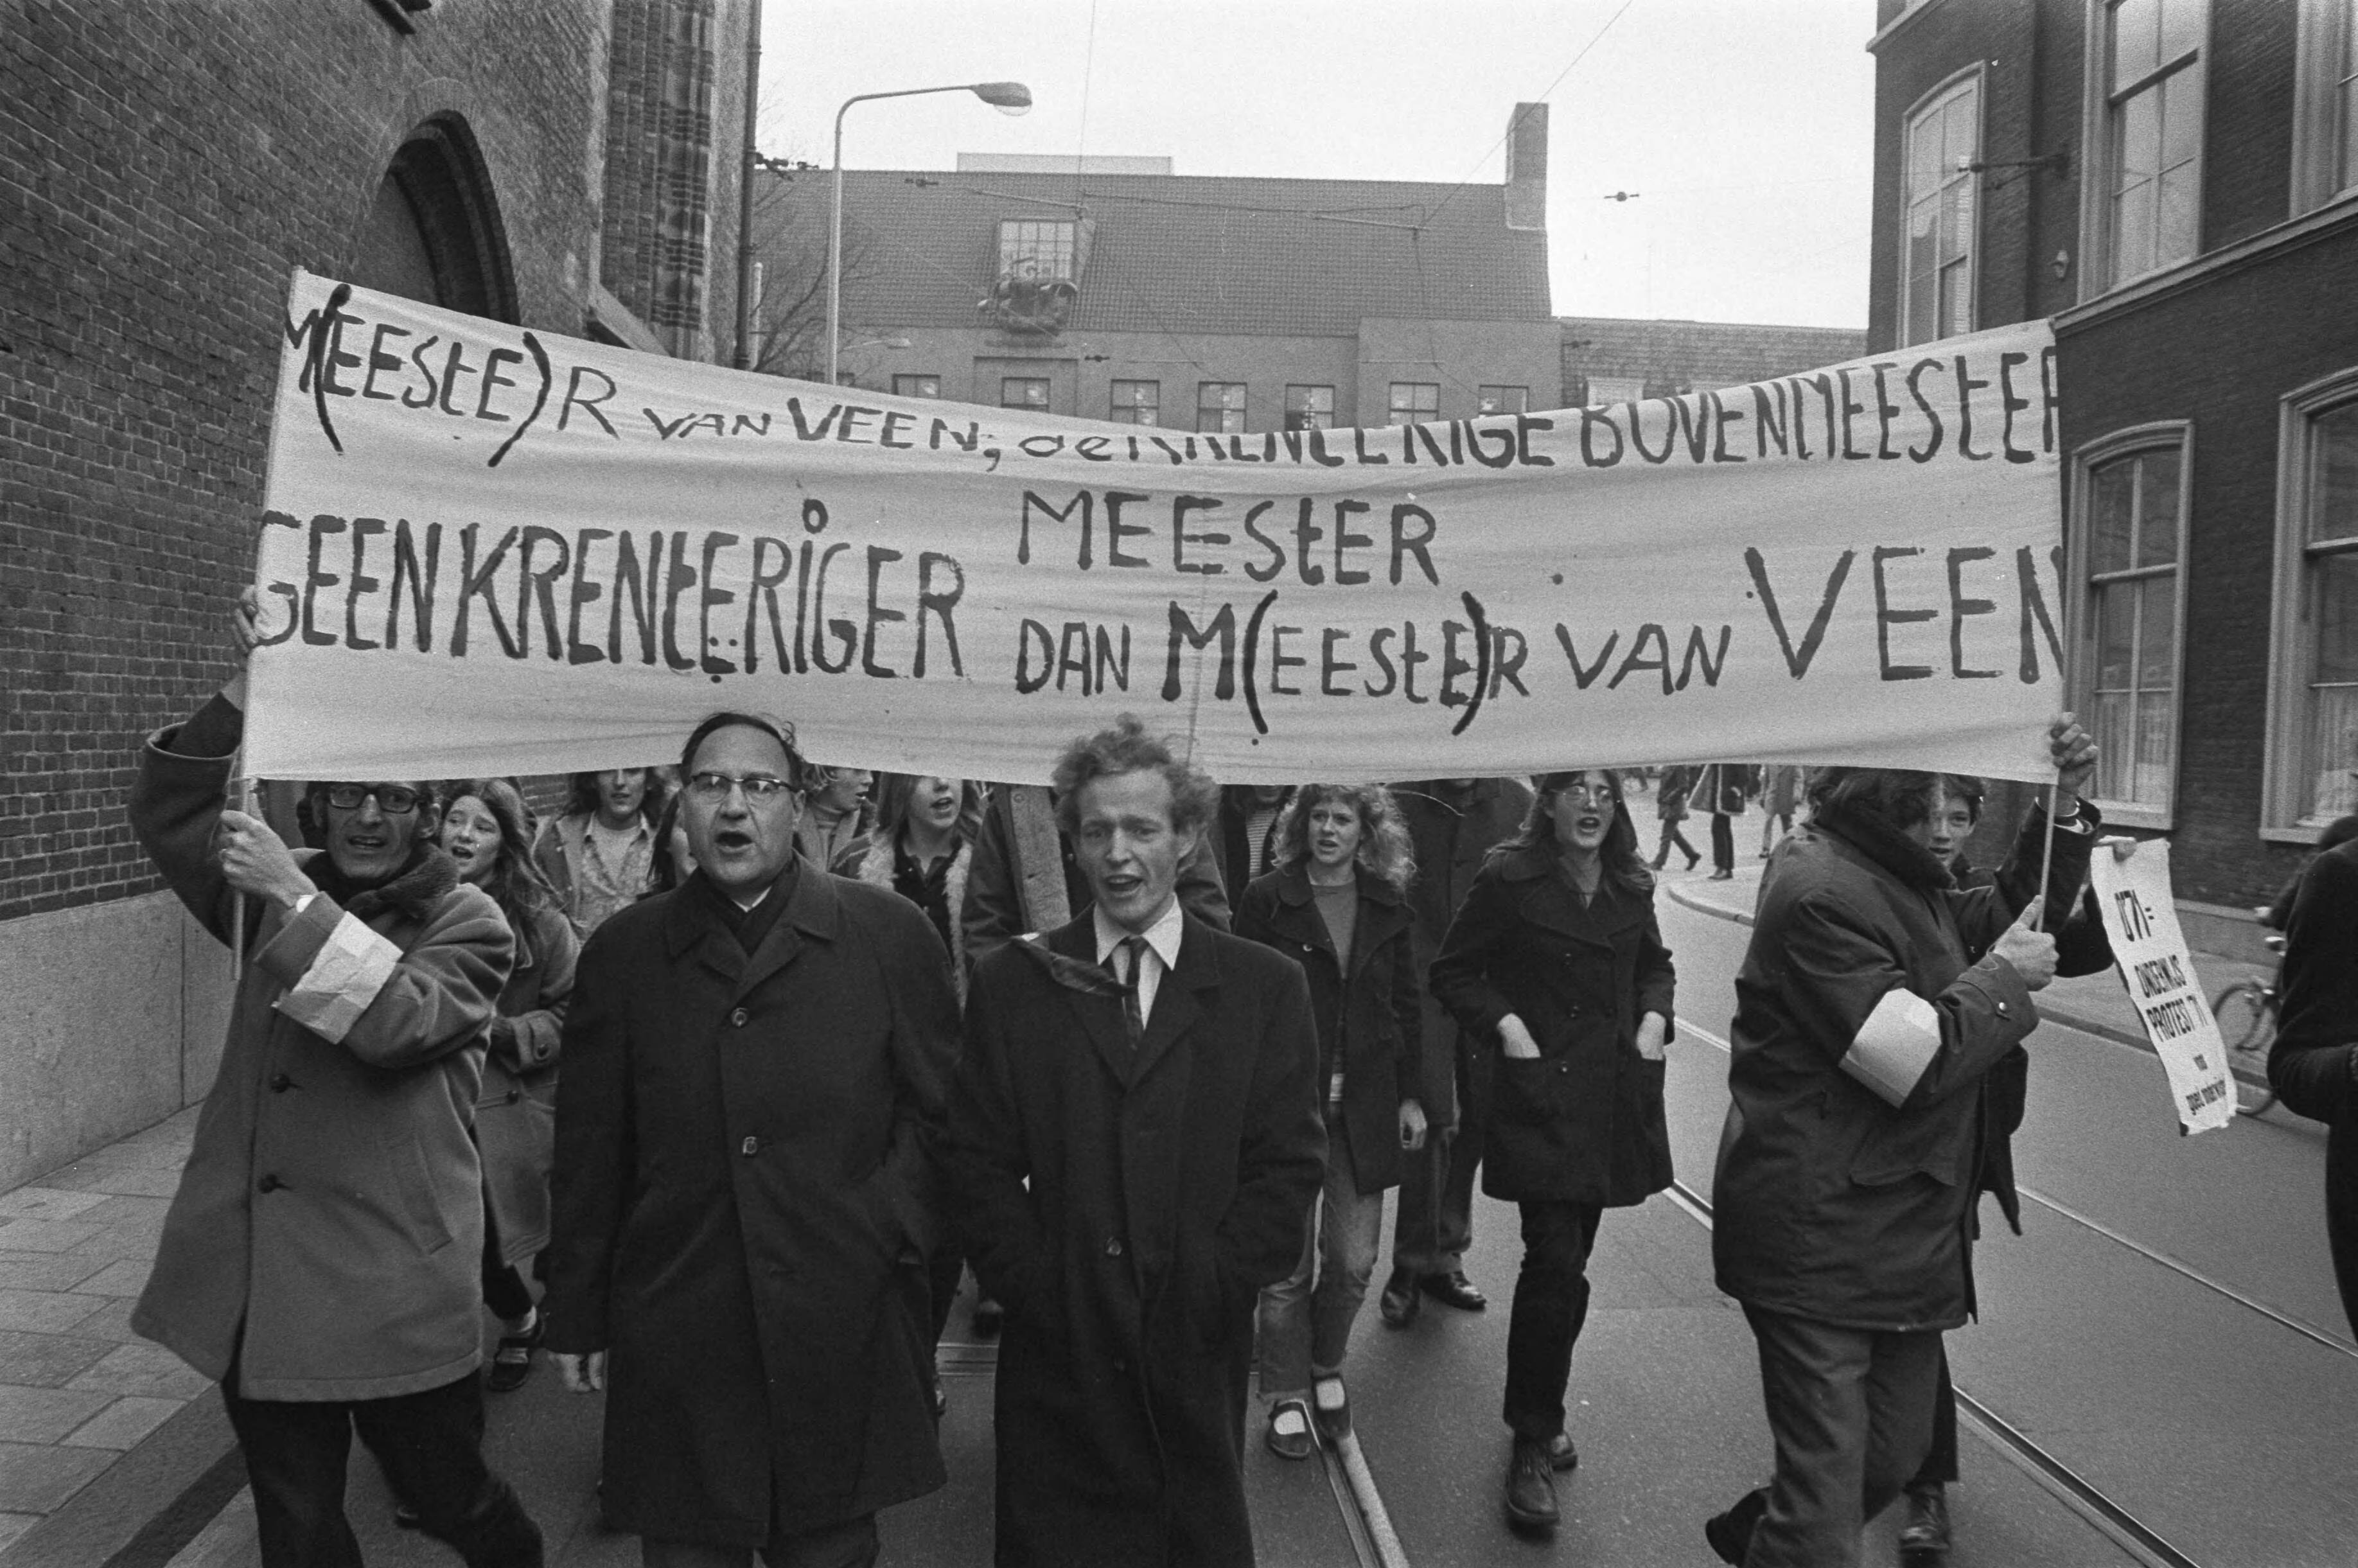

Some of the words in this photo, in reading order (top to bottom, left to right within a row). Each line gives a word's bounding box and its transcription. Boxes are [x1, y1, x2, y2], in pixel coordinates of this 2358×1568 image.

[643, 407, 771, 441] VAN
[1015, 618, 1131, 696] DAN
[1555, 623, 1732, 695] VAN
[1745, 545, 2064, 685] VEEN
[2146, 998, 2195, 1042] PROTEST
